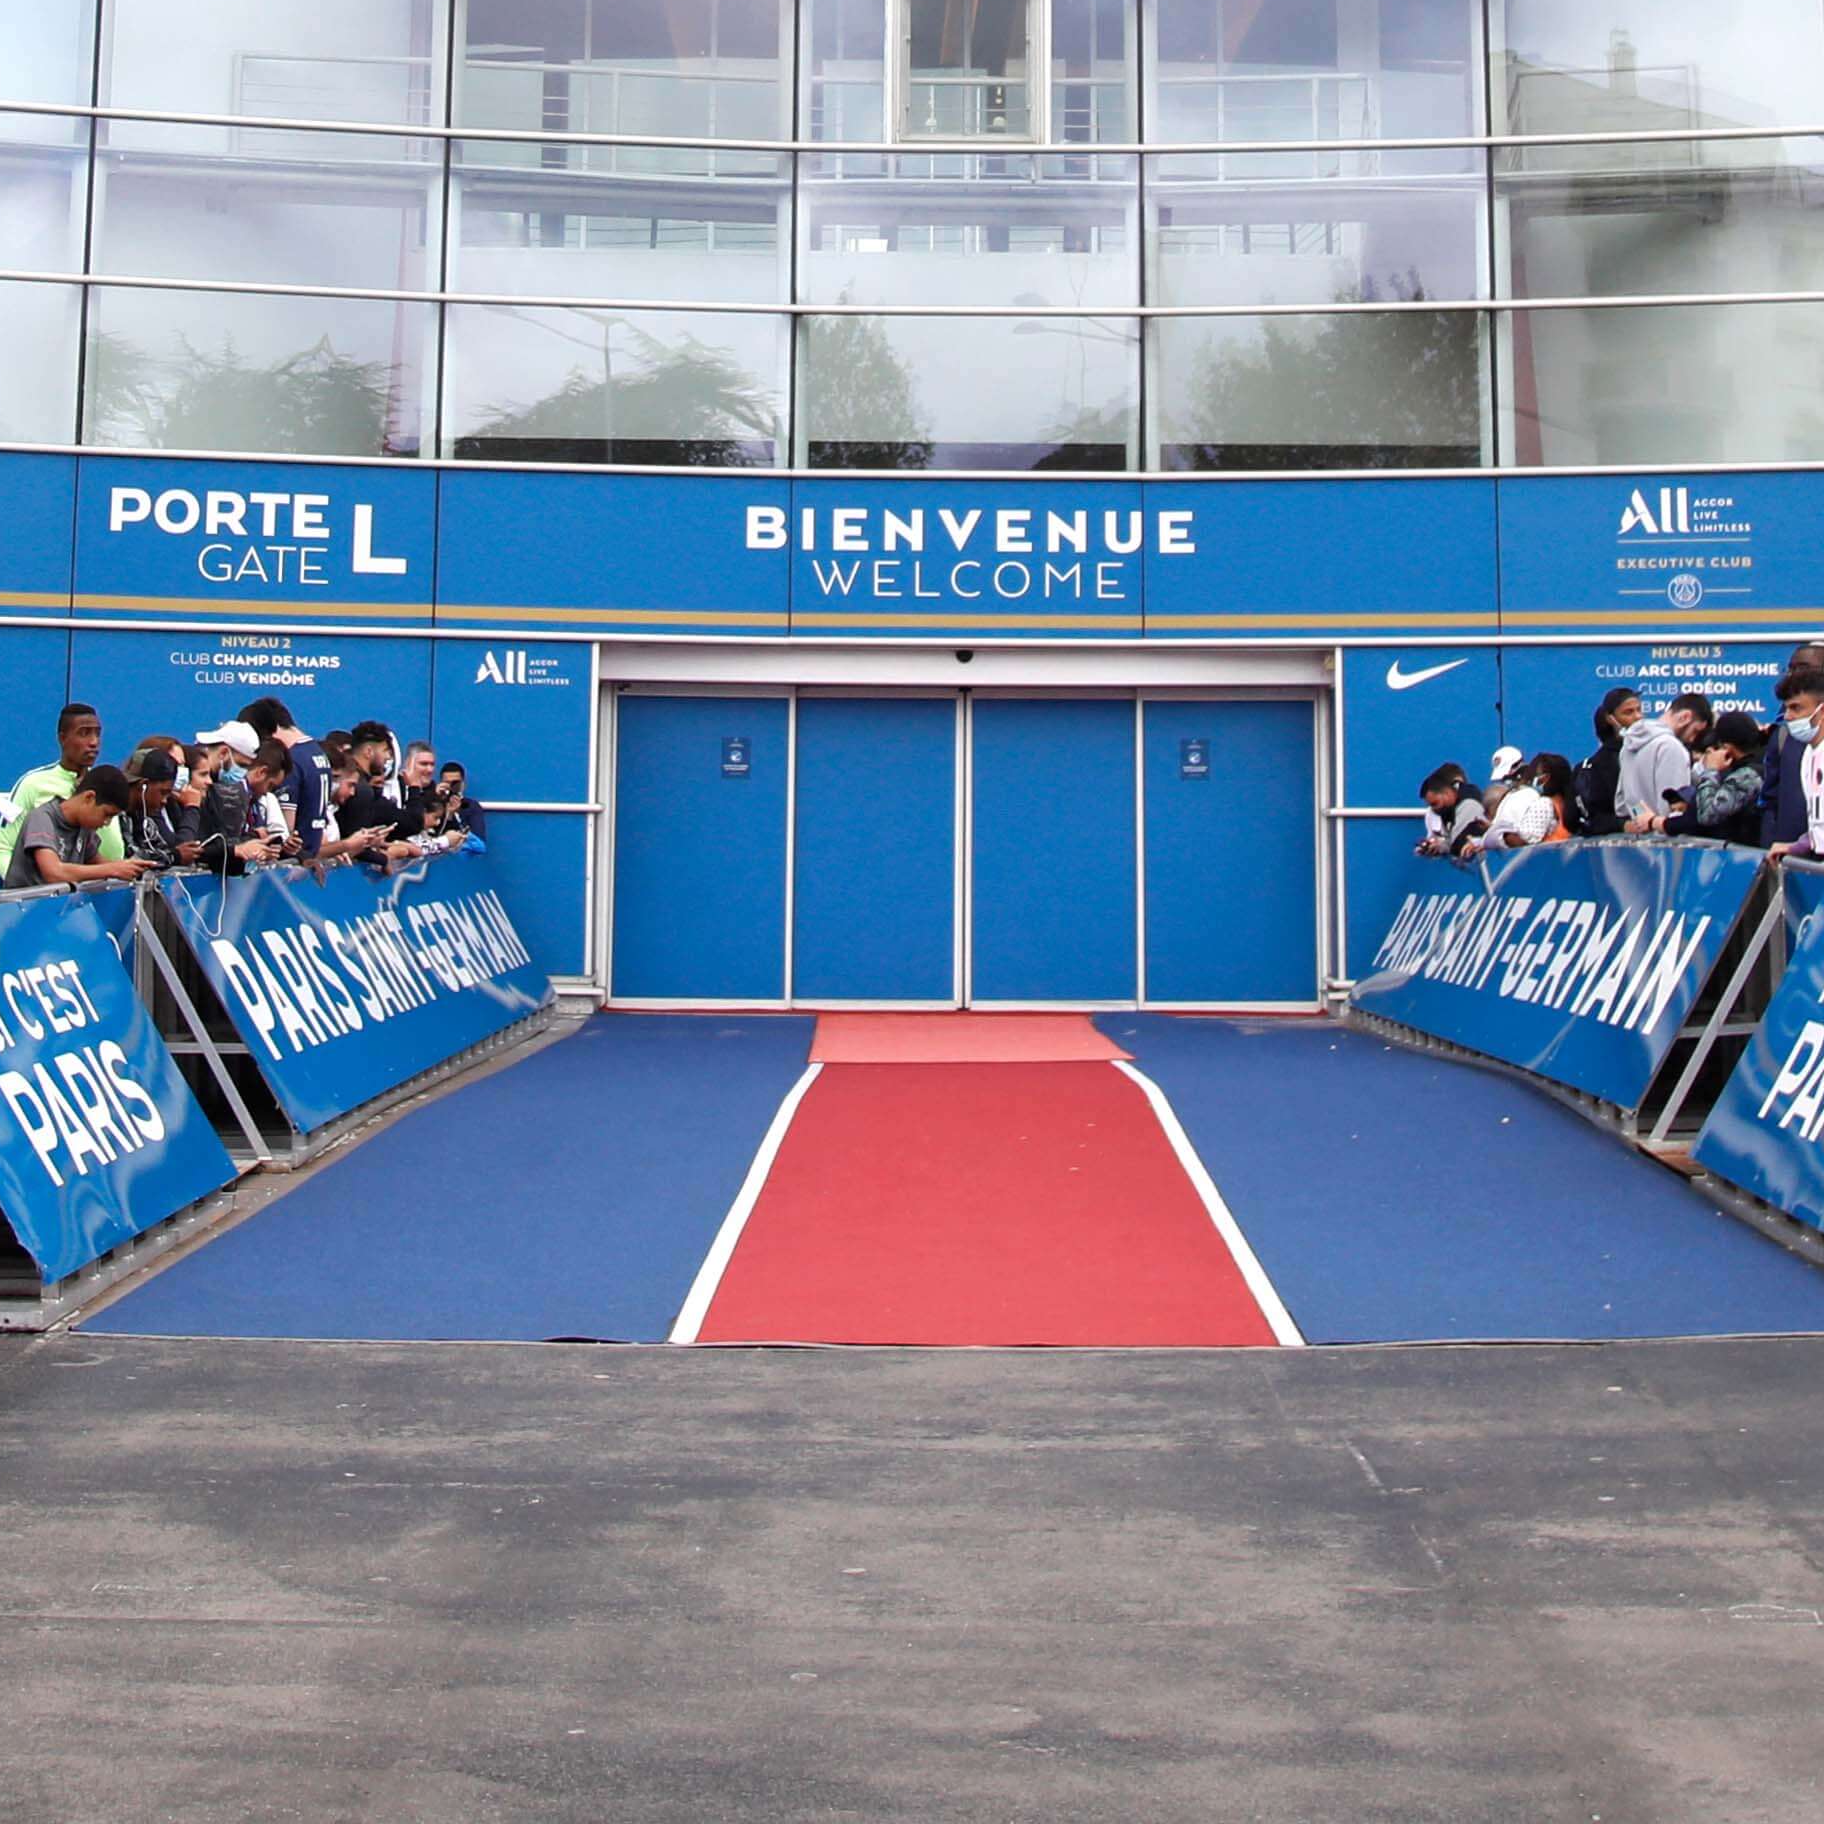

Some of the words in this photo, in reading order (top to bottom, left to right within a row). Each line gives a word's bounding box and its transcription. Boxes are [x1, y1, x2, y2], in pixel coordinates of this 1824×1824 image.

[1693, 497, 1734, 508] ACCOR
[1693, 511, 1719, 520] LIVE
[109, 486, 331, 539] PORTE
[352, 503, 408, 575] L
[744, 505, 1197, 555] BIENVENUE
[1693, 523, 1752, 533] LIMITLESS
[197, 543, 329, 585] GATE
[1616, 556, 1705, 570] EXECUTIVE
[1710, 555, 1753, 568] CLUB
[811, 559, 1127, 600] WELCOME
[221, 635, 279, 649] NIVEAU
[281, 637, 292, 650] 2
[169, 652, 211, 666] CLUB
[213, 653, 270, 667] CHAMP
[271, 655, 293, 668] DE
[295, 655, 341, 669] MARS
[1651, 646, 1710, 659] NIVEAU
[1712, 646, 1723, 658] 3
[194, 670, 235, 684] CLUB
[237, 670, 316, 686] VENDÔME
[1595, 664, 1636, 678] CLUB
[1637, 664, 1671, 677] ARC
[1673, 664, 1696, 677] DE
[1697, 663, 1780, 676] TRIOMPHE
[1680, 681, 1737, 695] ODÉON
[1371, 892, 1458, 976] PARIS
[210, 922, 364, 1061] PARIS
[2, 959, 101, 1041] C'EST
